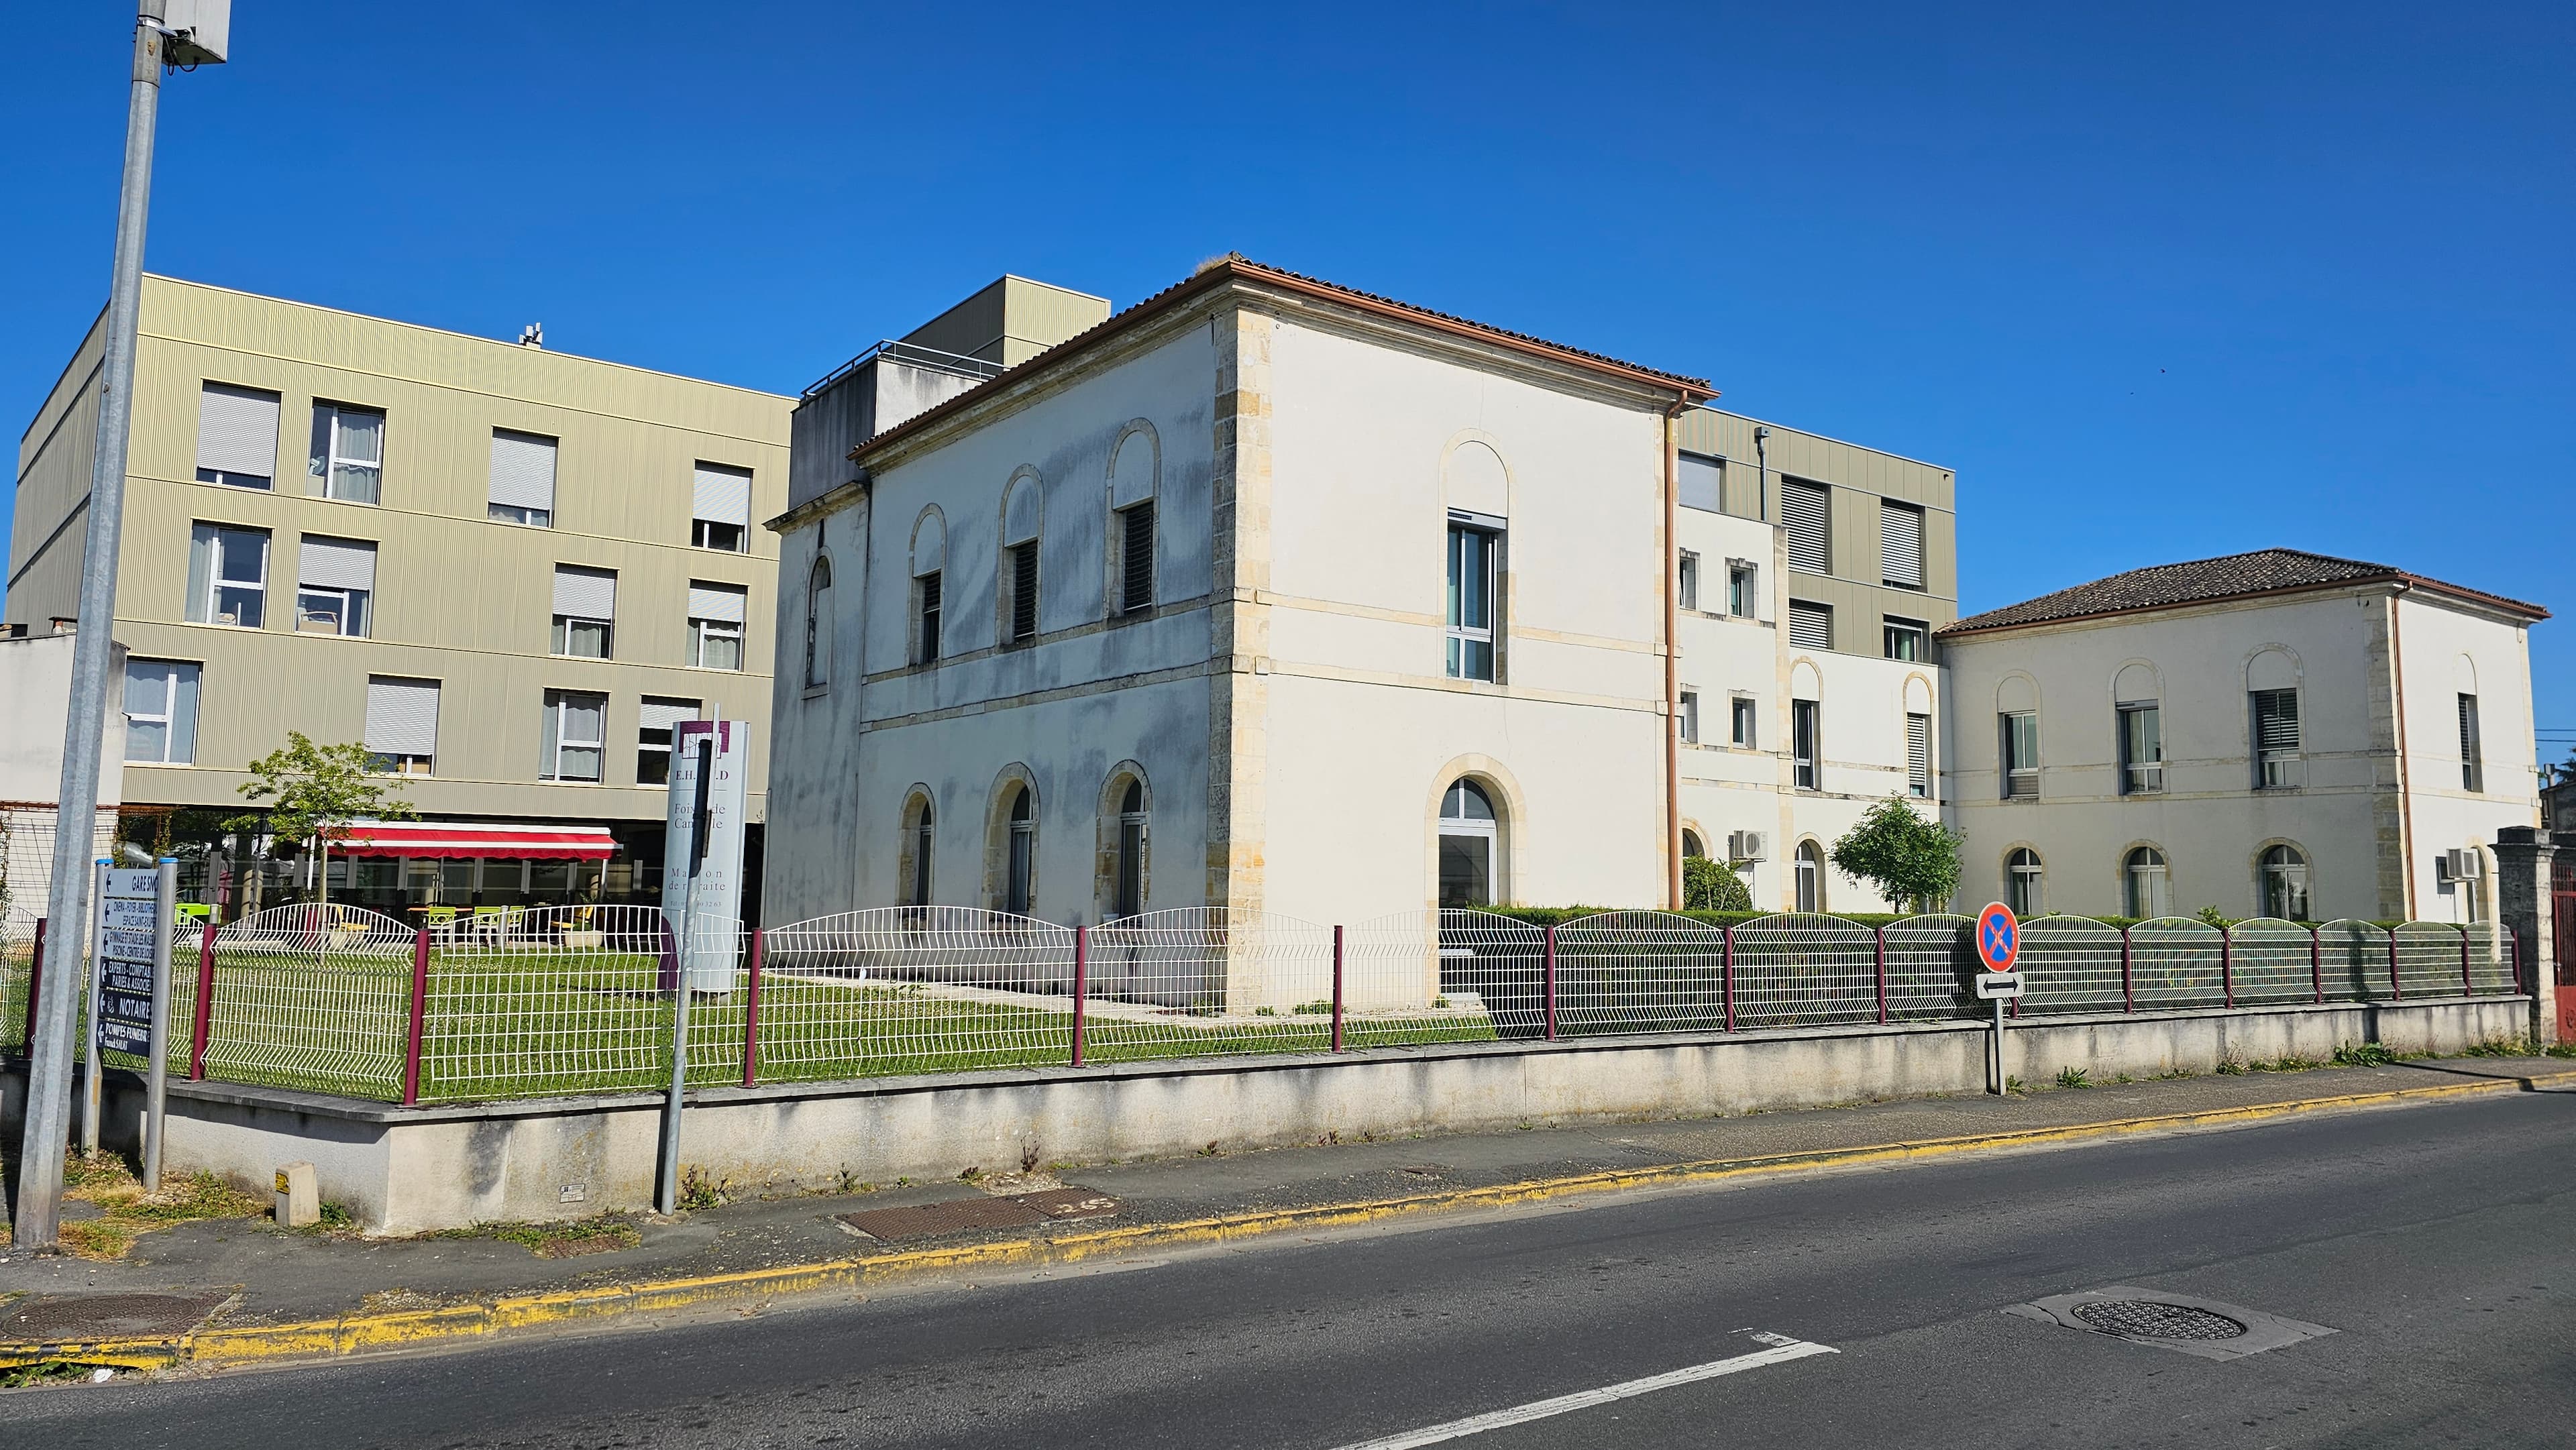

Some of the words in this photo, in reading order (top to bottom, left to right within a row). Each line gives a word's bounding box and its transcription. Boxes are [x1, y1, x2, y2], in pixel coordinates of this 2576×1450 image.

[672, 868, 722, 878] Maon
[132, 875, 146, 891] GARE
[669, 881, 678, 890] de
[109, 961, 126, 974] EXPERTS
[105, 1022, 126, 1038] POMPES
